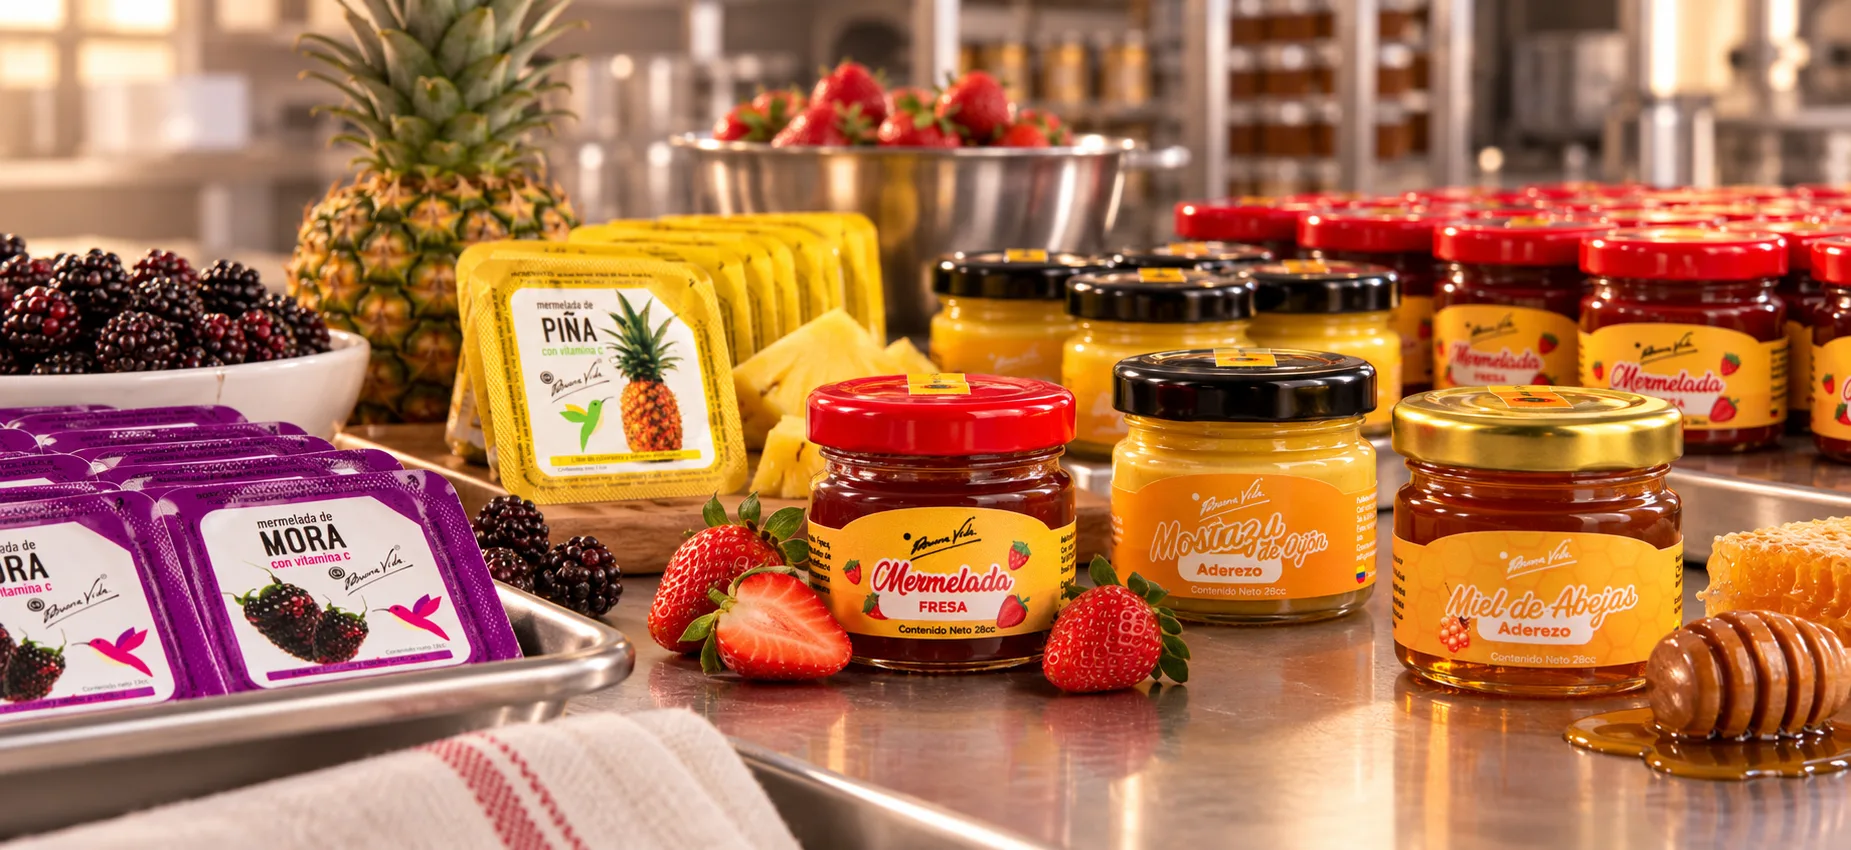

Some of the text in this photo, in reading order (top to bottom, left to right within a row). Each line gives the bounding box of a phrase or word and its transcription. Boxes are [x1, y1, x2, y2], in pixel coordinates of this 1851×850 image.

[536, 301, 593, 311] mermelada de
[541, 311, 598, 343] PIÑA
[542, 348, 558, 357] con
[560, 346, 596, 356] vitamina
[1611, 364, 1723, 392] Mermelada
[257, 511, 333, 529] mermelada de
[22, 540, 36, 551] de
[259, 523, 347, 557] MORA
[1258, 538, 1282, 561] de
[271, 552, 351, 570] con vitamina c
[1196, 562, 1263, 577] Aderezo
[872, 560, 1014, 596] Mermelada
[45, 583, 52, 592] c
[1190, 585, 1287, 596] Contenido Neto 28cc
[918, 601, 968, 613] FRESA
[1446, 584, 1506, 619] Miel
[1509, 591, 1544, 619] de
[1550, 584, 1638, 630] Abejas
[898, 624, 996, 635] Contenido Neto 28cc
[1497, 622, 1571, 637] Aderezo
[1490, 651, 1597, 665] Contenido Neto 28cc
